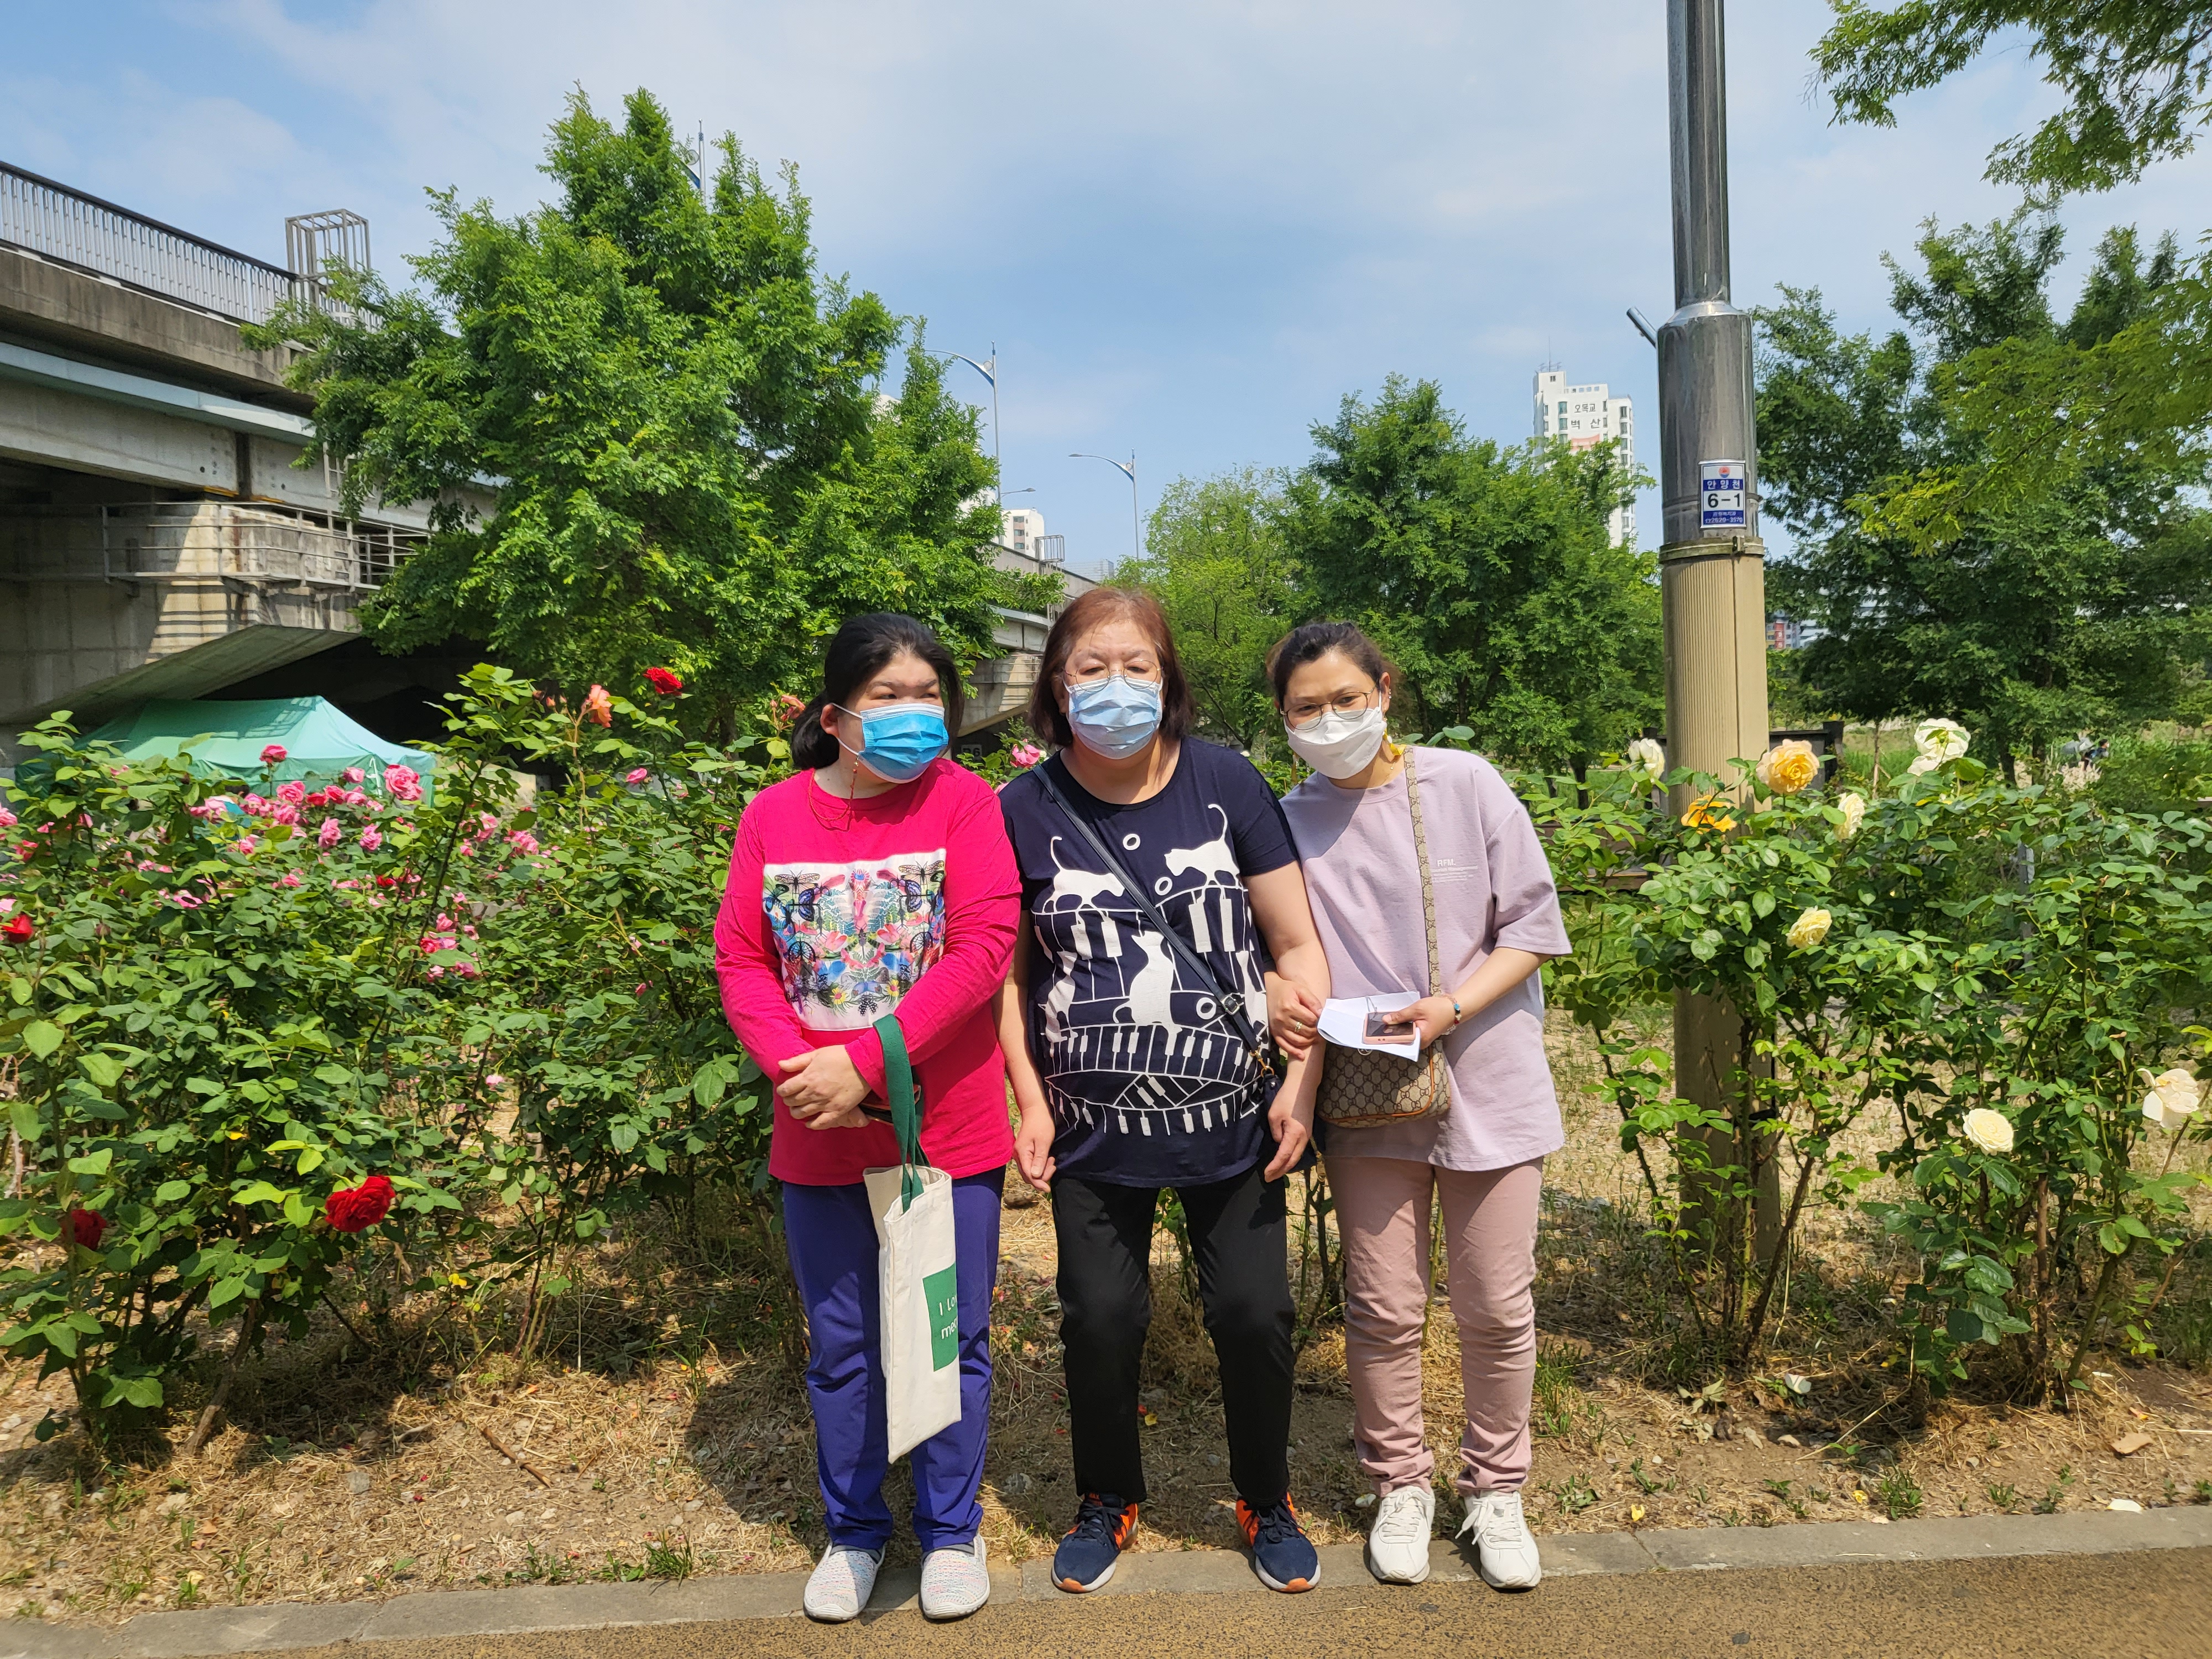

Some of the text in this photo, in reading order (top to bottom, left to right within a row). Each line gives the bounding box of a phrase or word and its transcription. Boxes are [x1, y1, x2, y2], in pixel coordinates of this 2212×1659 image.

[1574, 403, 1596, 413] 오목교
[1707, 479, 1740, 489] 안양천
[1708, 493, 1740, 508] 6-1
